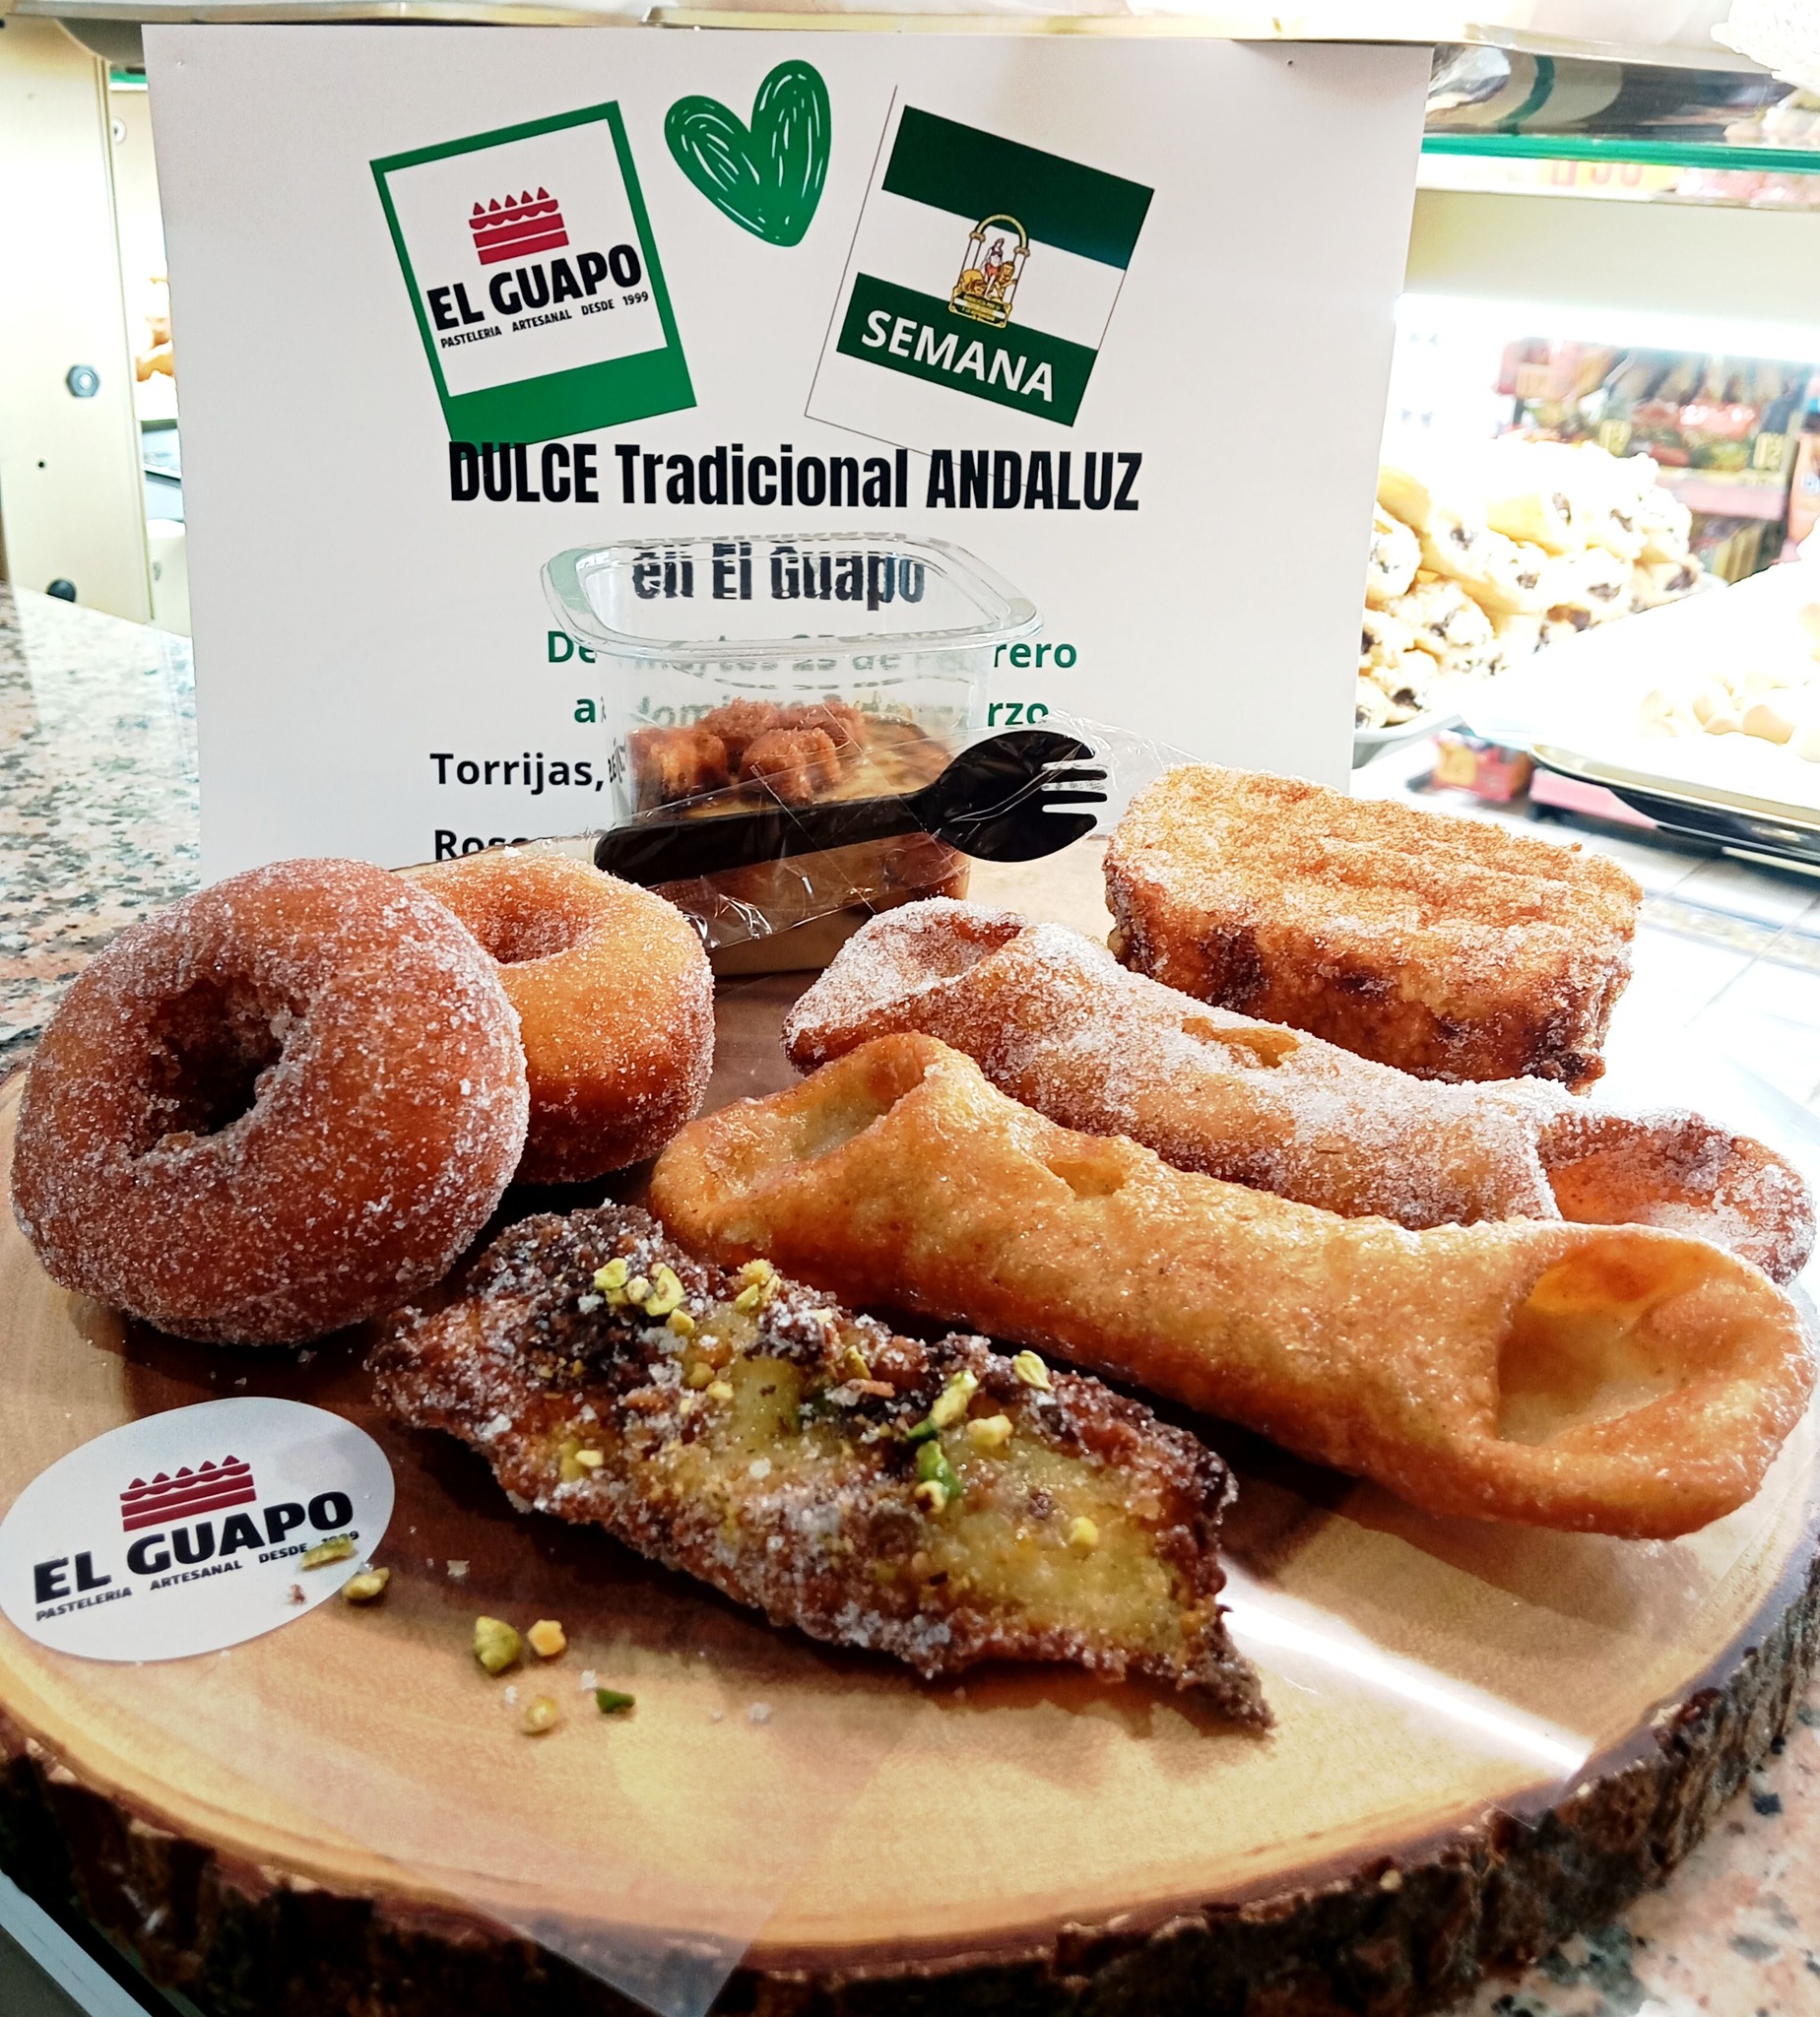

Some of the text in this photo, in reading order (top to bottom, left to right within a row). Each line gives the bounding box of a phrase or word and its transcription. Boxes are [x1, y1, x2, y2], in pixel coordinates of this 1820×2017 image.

[426, 244, 642, 331] EL GUAPO
[440, 292, 649, 349] PASTELERIA ARTESANAL DESDE 1999
[861, 309, 1054, 403] SEMANA
[448, 441, 1142, 511] DULCE Tradicional ANDALUZ
[711, 542, 752, 600] El
[770, 541, 925, 611] Guapo
[994, 642, 1077, 669] rero
[429, 751, 604, 796] Torrijas,
[33, 1490, 354, 1604] EL GUAPO
[35, 1542, 307, 1622] PASTELERIA ARTESANAL DESDE
